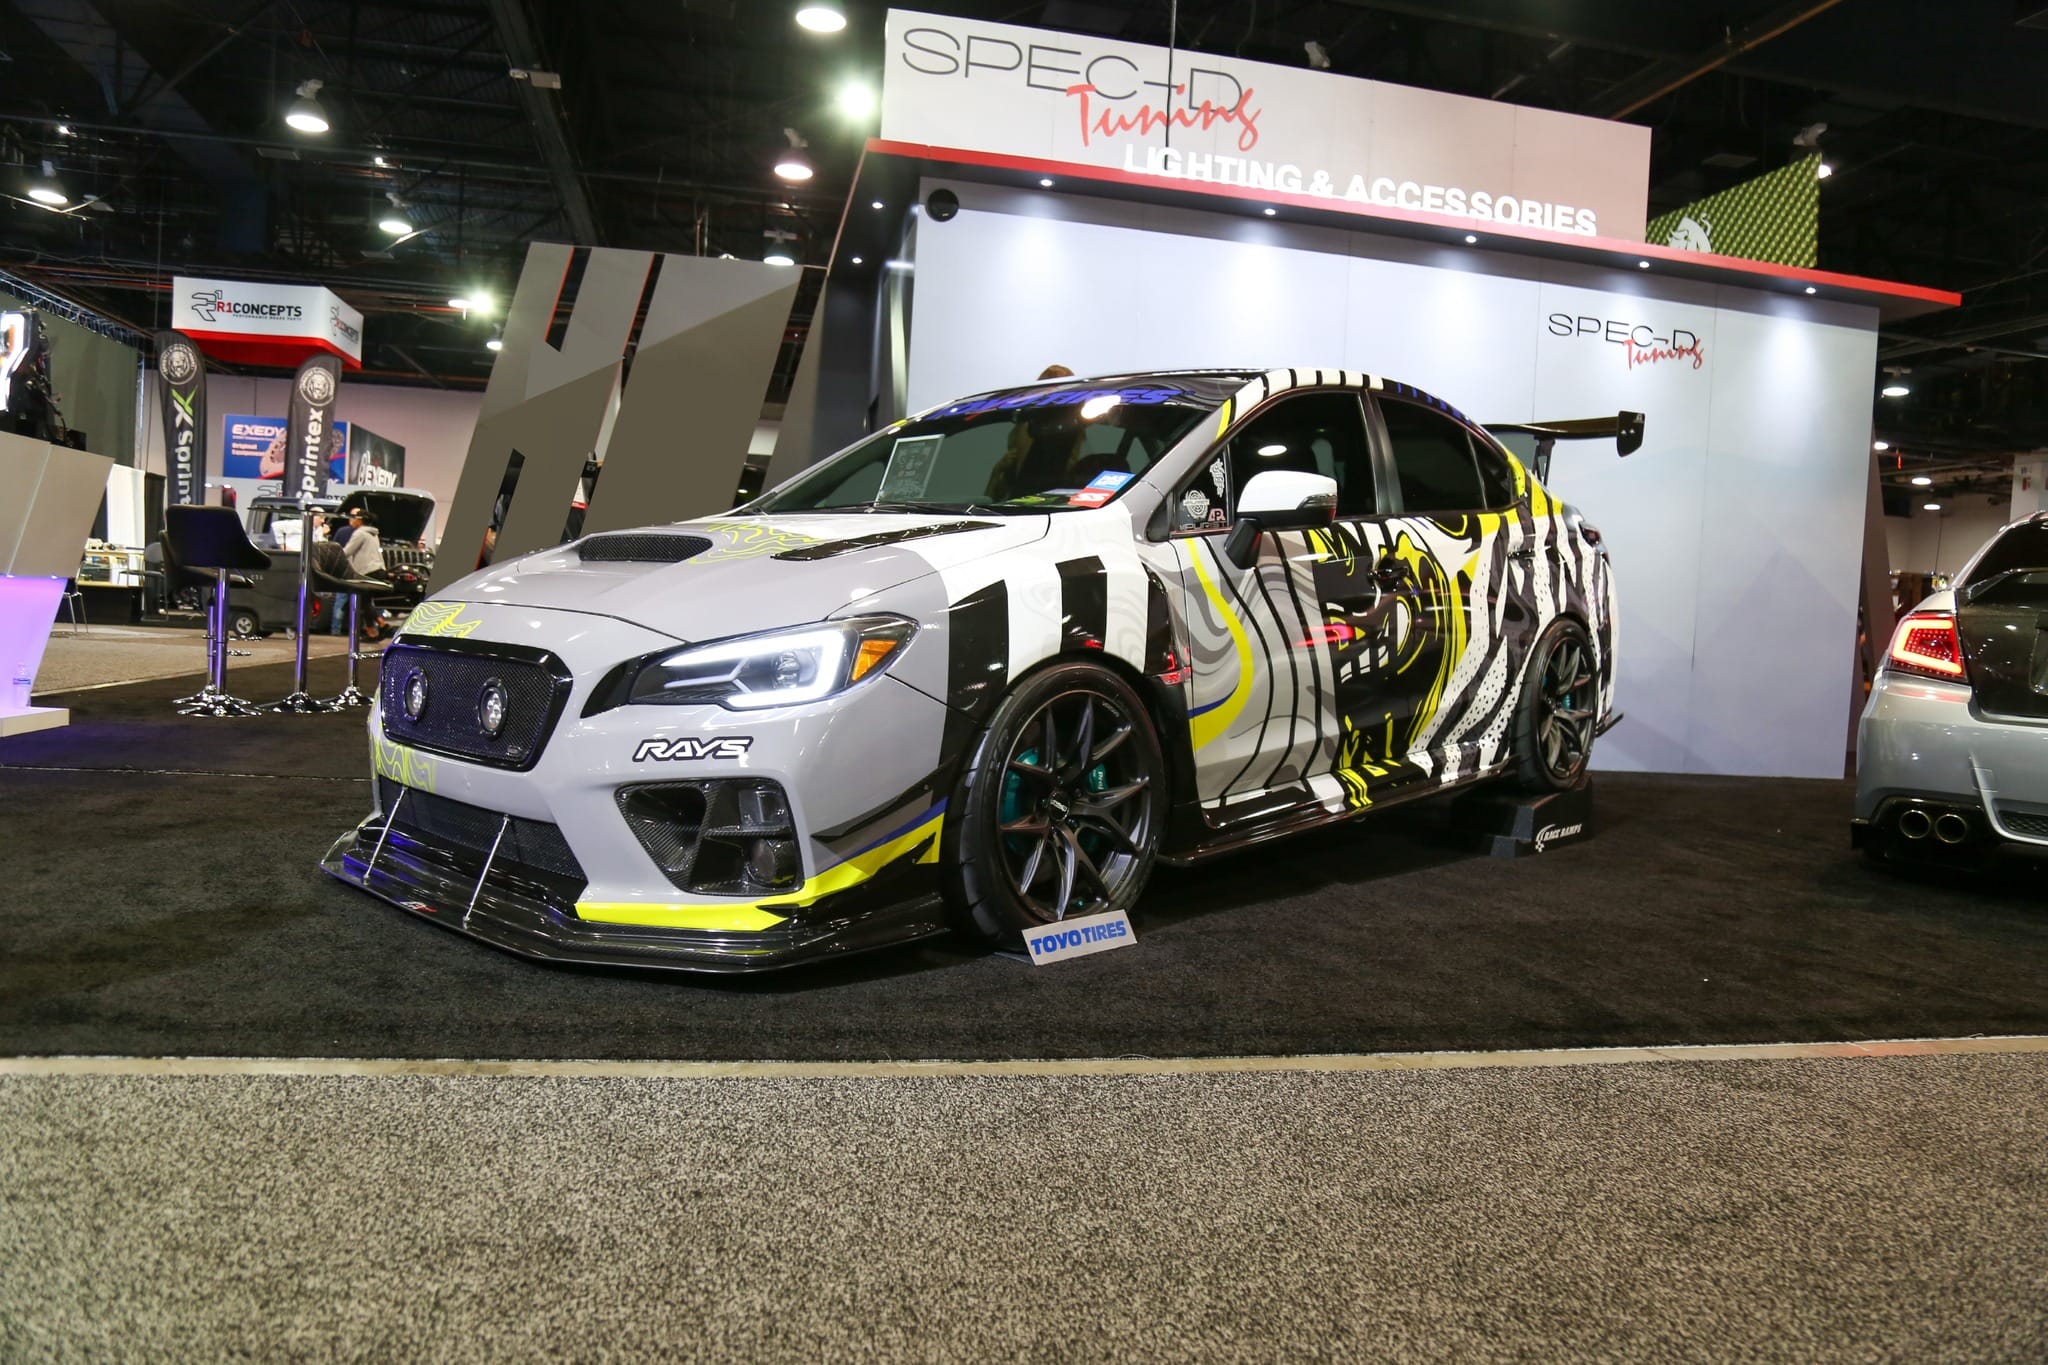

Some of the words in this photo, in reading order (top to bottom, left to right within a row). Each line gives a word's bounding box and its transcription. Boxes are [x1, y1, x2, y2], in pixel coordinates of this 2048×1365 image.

[902, 27, 1243, 114] SPEC-D
[1066, 83, 1262, 152] Tuning
[1124, 143, 1302, 195] LIGHTING
[1309, 169, 1335, 198] &
[1344, 174, 1598, 237] ACCESSORIES
[1548, 313, 1697, 351] SPEC-D
[1623, 338, 1704, 370] Tuning
[633, 737, 753, 761] RAYS
[1030, 930, 1082, 956] TOYO
[1081, 920, 1127, 944] TIRES
